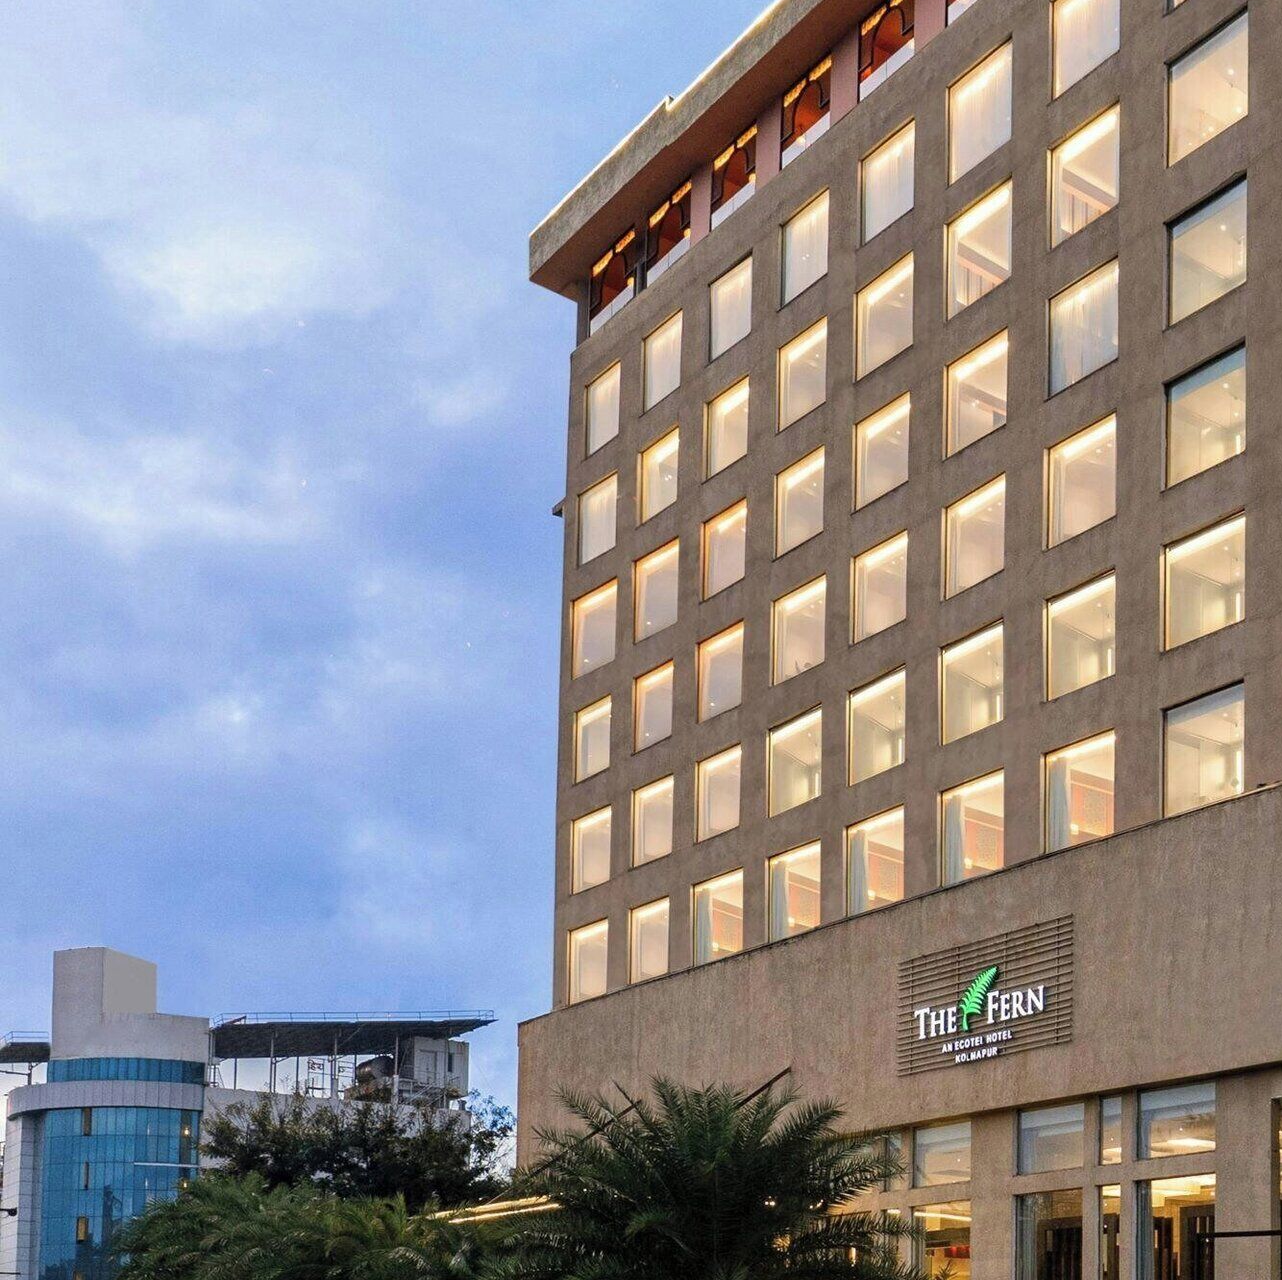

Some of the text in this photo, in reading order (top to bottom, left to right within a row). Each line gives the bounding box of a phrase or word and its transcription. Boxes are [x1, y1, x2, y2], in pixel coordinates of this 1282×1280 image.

[914, 985, 1045, 1040] THE FERN
[942, 1043, 953, 1053] AN
[986, 1030, 1012, 1043] HOTEL
[955, 1047, 997, 1064] KOLHAPUR
